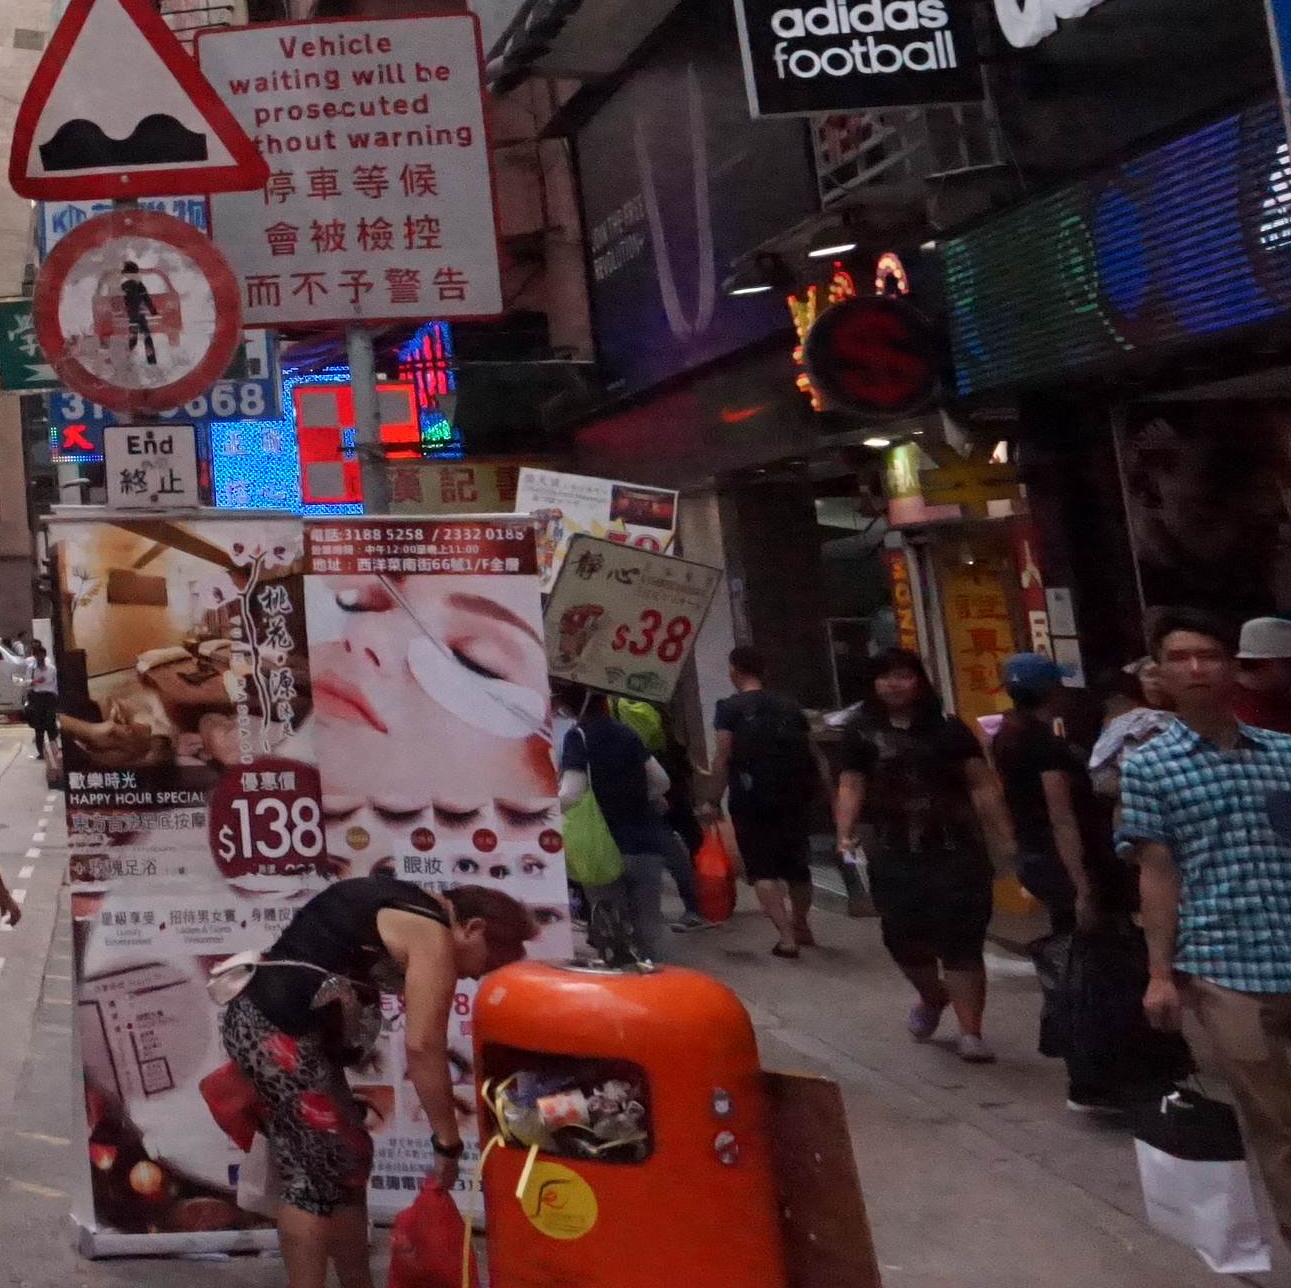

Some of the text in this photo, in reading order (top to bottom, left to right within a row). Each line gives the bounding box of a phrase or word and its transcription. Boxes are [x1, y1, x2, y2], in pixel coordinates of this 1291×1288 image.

[279, 33, 392, 61] Vehicle
[774, 30, 958, 79] football
[229, 61, 451, 96] waiting will be
[254, 93, 430, 128] prosecuted
[253, 123, 473, 156] thout warning
[263, 163, 438, 205] 停車等候
[265, 215, 443, 257] 會被檢控
[246, 266, 470, 309] 而不予警告
[127, 433, 174, 456] End
[120, 468, 185, 494] 終止
[386, 527, 424, 541] 5258
[443, 527, 481, 541] 2332
[611, 609, 692, 663] $38
[69, 771, 137, 790] 歡樂時光
[69, 791, 205, 805] HAPPY HOUR SPECIAL
[219, 797, 324, 863] $138
[370, 1175, 424, 1191] 查詢電
